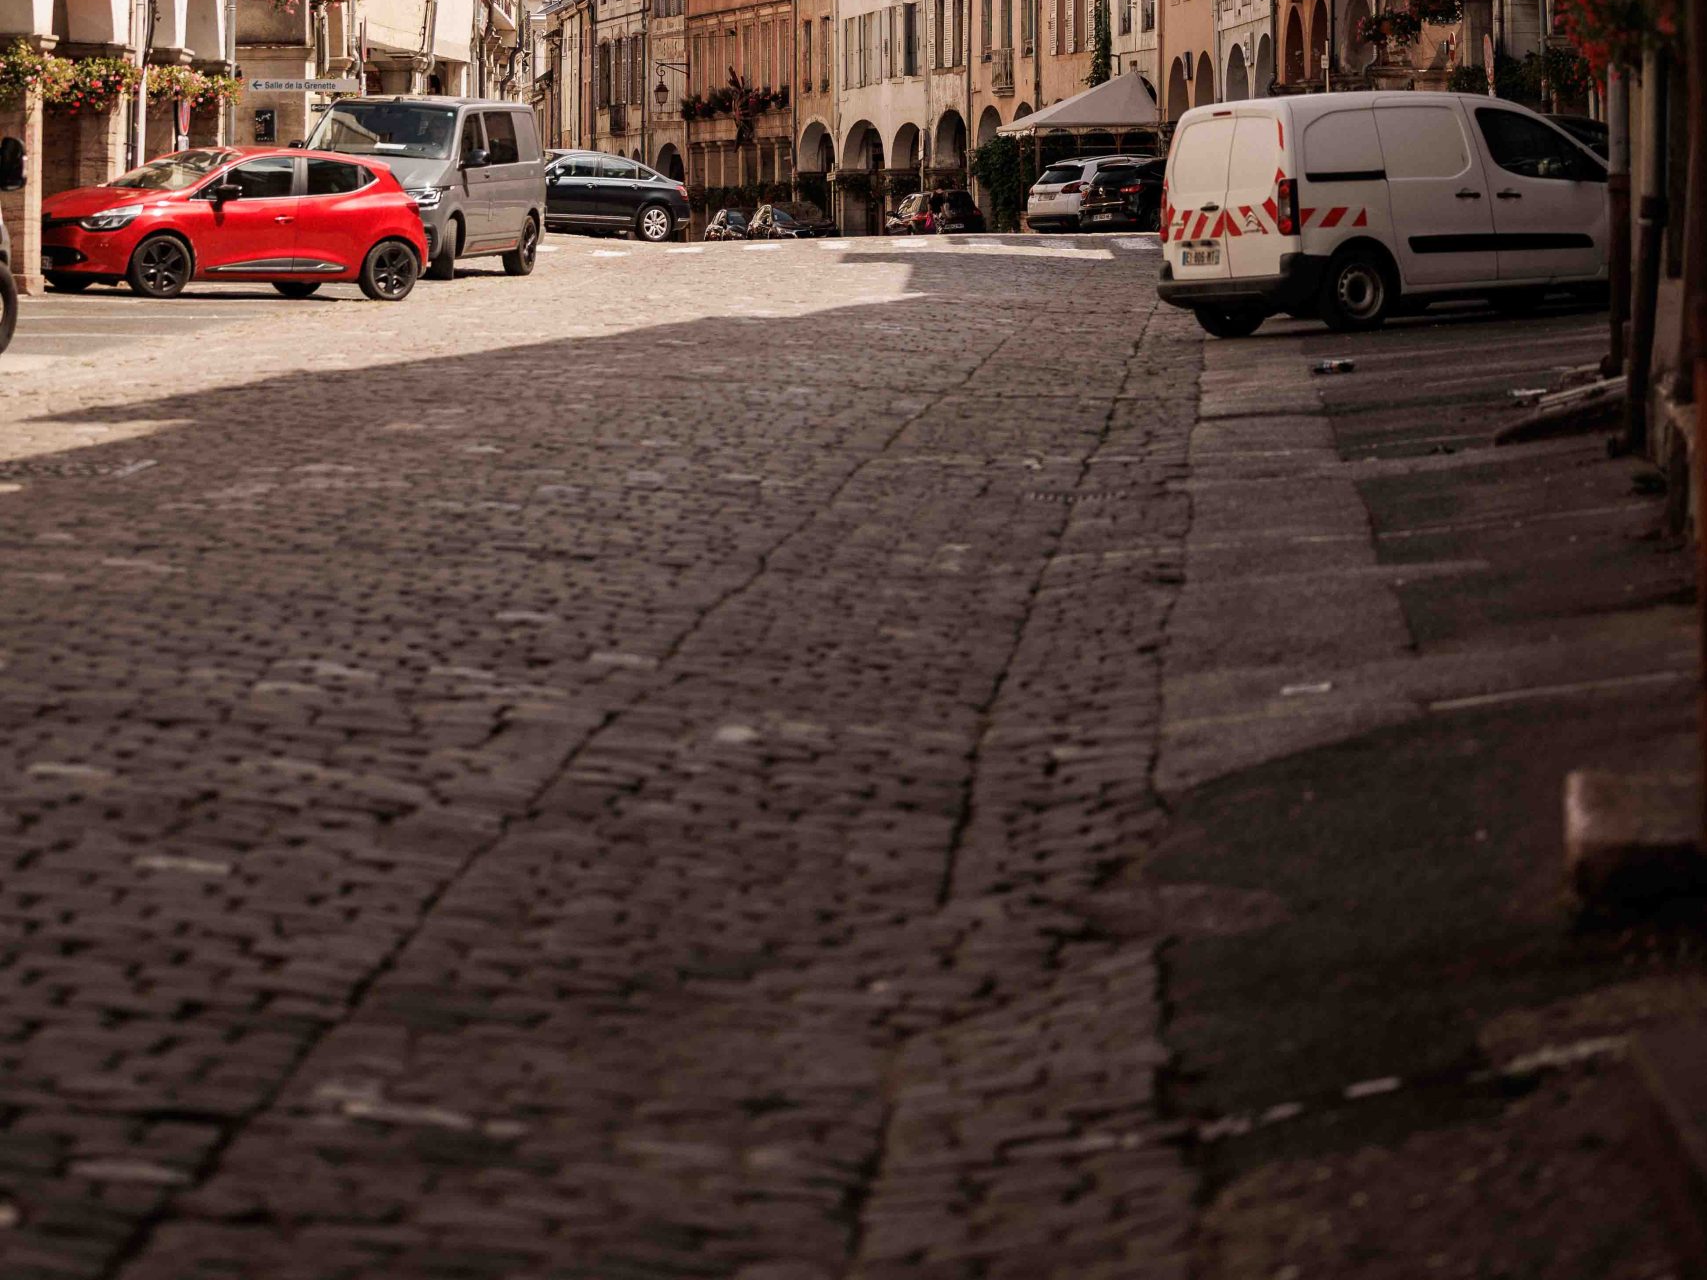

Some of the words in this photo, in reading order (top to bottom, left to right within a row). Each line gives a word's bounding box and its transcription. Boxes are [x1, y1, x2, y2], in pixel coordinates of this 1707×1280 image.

[264, 81, 283, 89] Salle
[284, 81, 294, 89] de
[295, 81, 303, 89] la
[304, 81, 336, 90] Grenette
